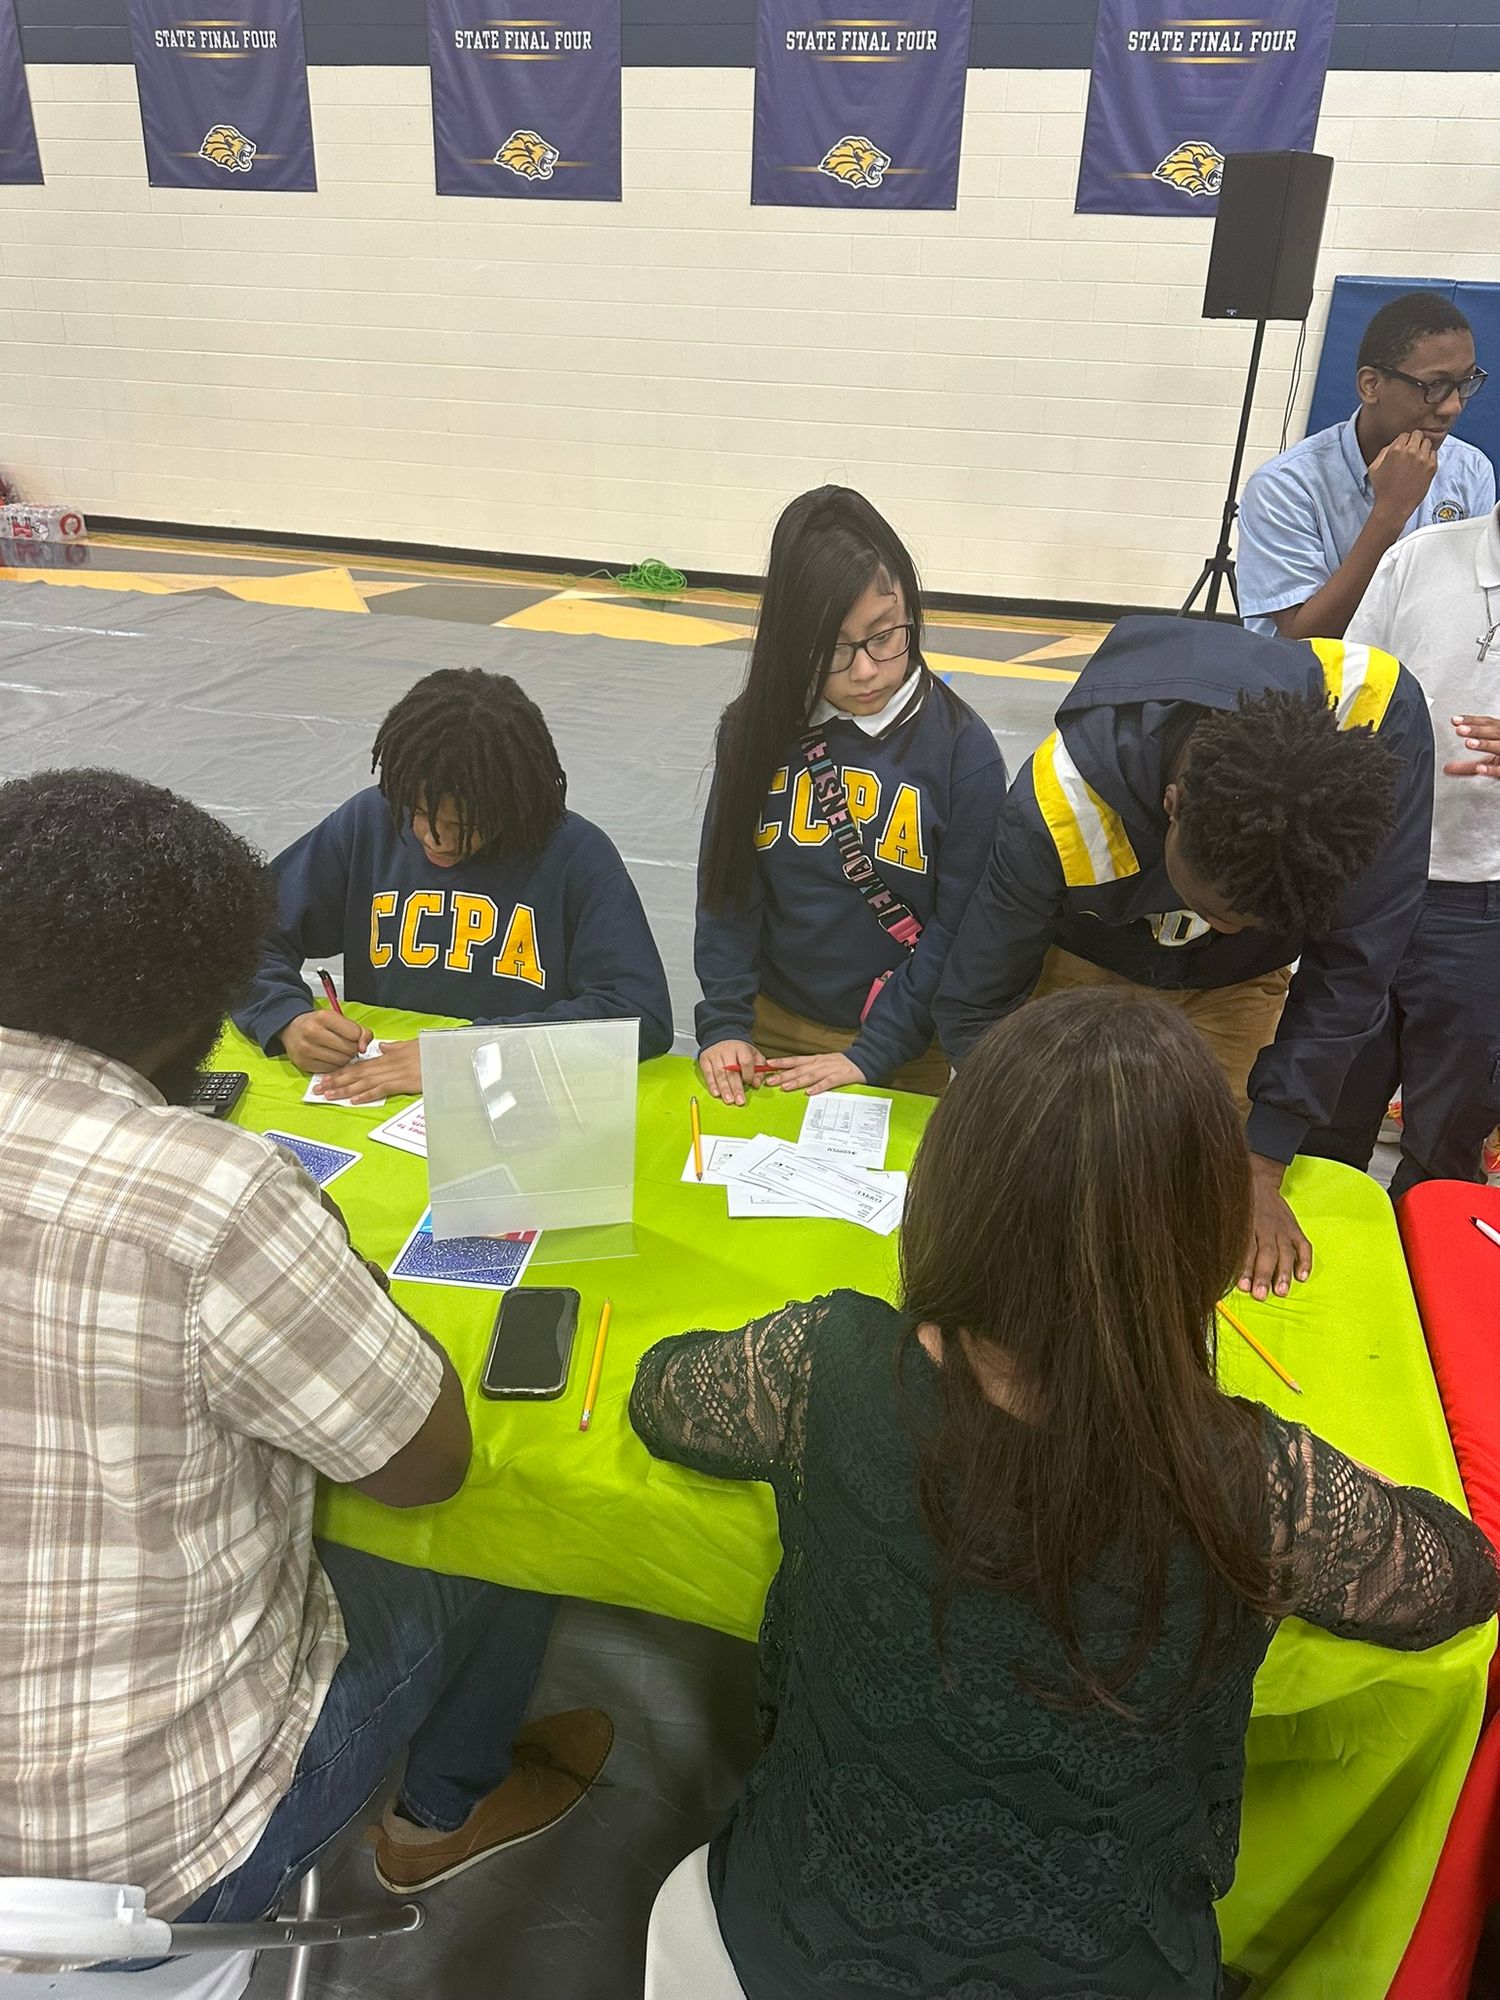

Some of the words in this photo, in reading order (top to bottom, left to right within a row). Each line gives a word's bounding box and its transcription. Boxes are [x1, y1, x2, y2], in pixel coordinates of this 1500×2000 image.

[154, 29, 196, 48] STATE
[200, 30, 239, 49] FINAL
[243, 30, 278, 49] FOUR
[454, 30, 499, 49] STATE
[504, 31, 550, 50] FINAL
[554, 31, 593, 50] FOUR
[785, 31, 836, 51] STATE
[841, 31, 891, 51] FINAL
[896, 30, 938, 51] FOUR
[1127, 30, 1185, 52] STATE
[1188, 31, 1243, 52] FINAL
[1249, 30, 1297, 52] FOUR
[369, 889, 547, 990] CCPA
